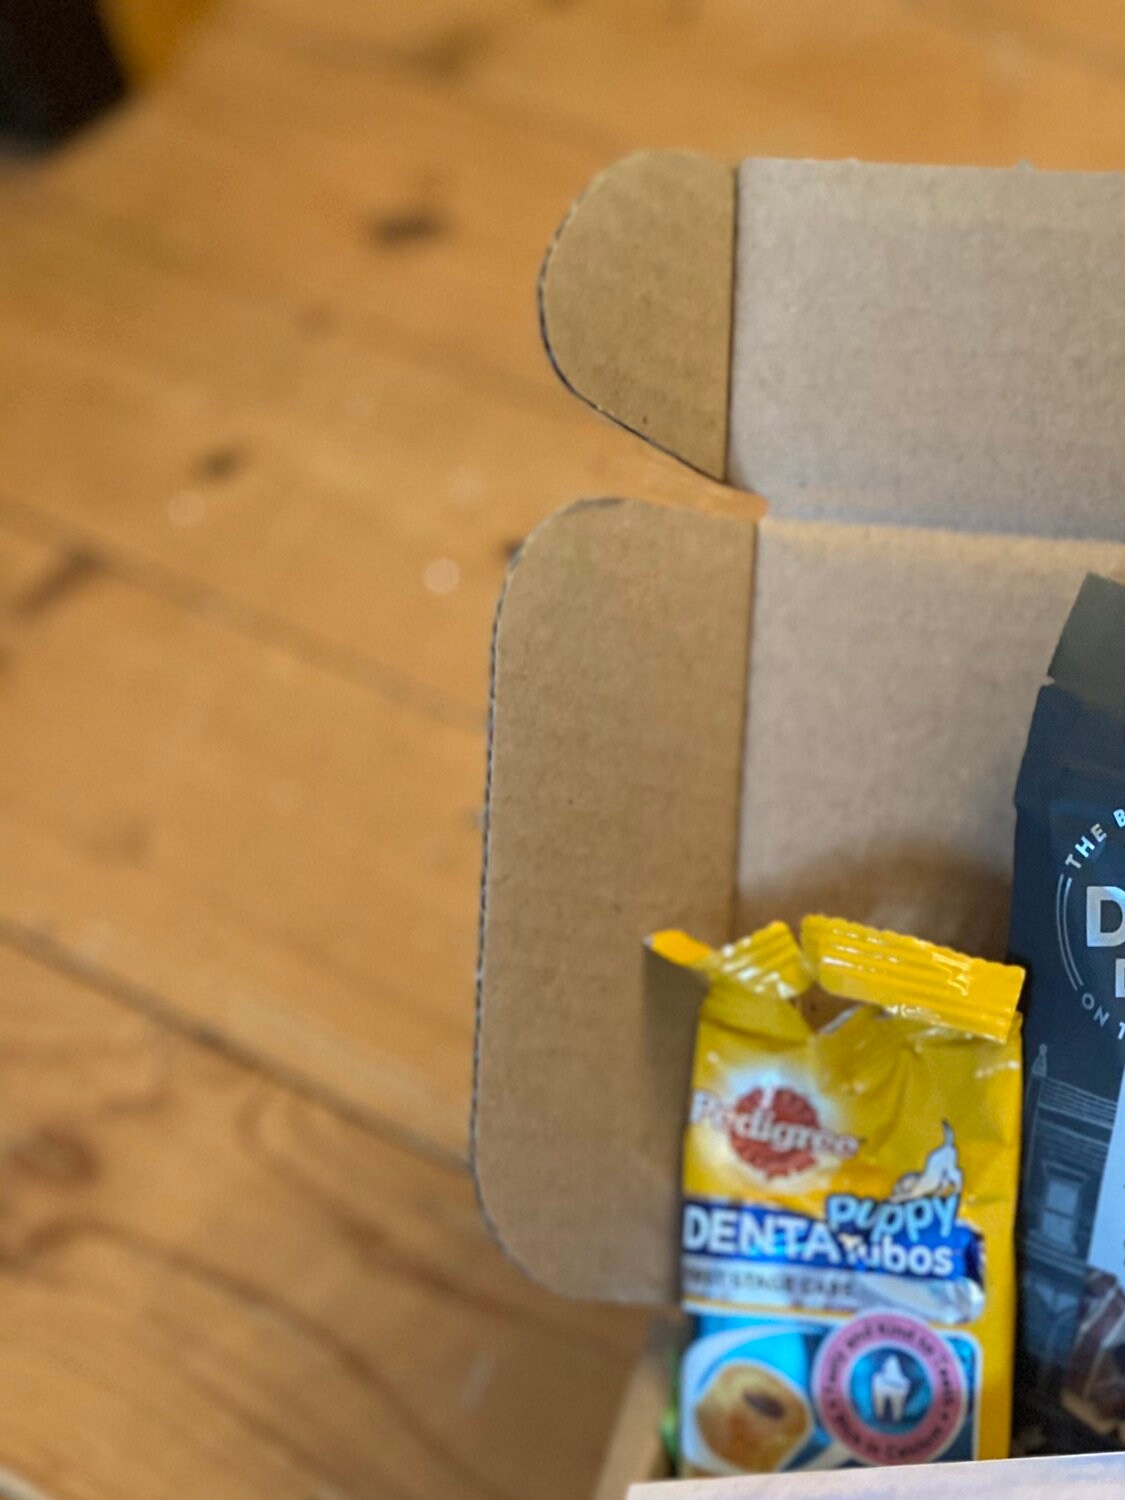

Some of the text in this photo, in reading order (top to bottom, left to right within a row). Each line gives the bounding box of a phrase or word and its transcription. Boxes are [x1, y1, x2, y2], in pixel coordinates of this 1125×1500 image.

[1065, 823, 1107, 869] THE
[1081, 993, 1110, 1028] ON
[690, 1088, 860, 1160] Pedigree
[682, 1203, 841, 1264] DENTA
